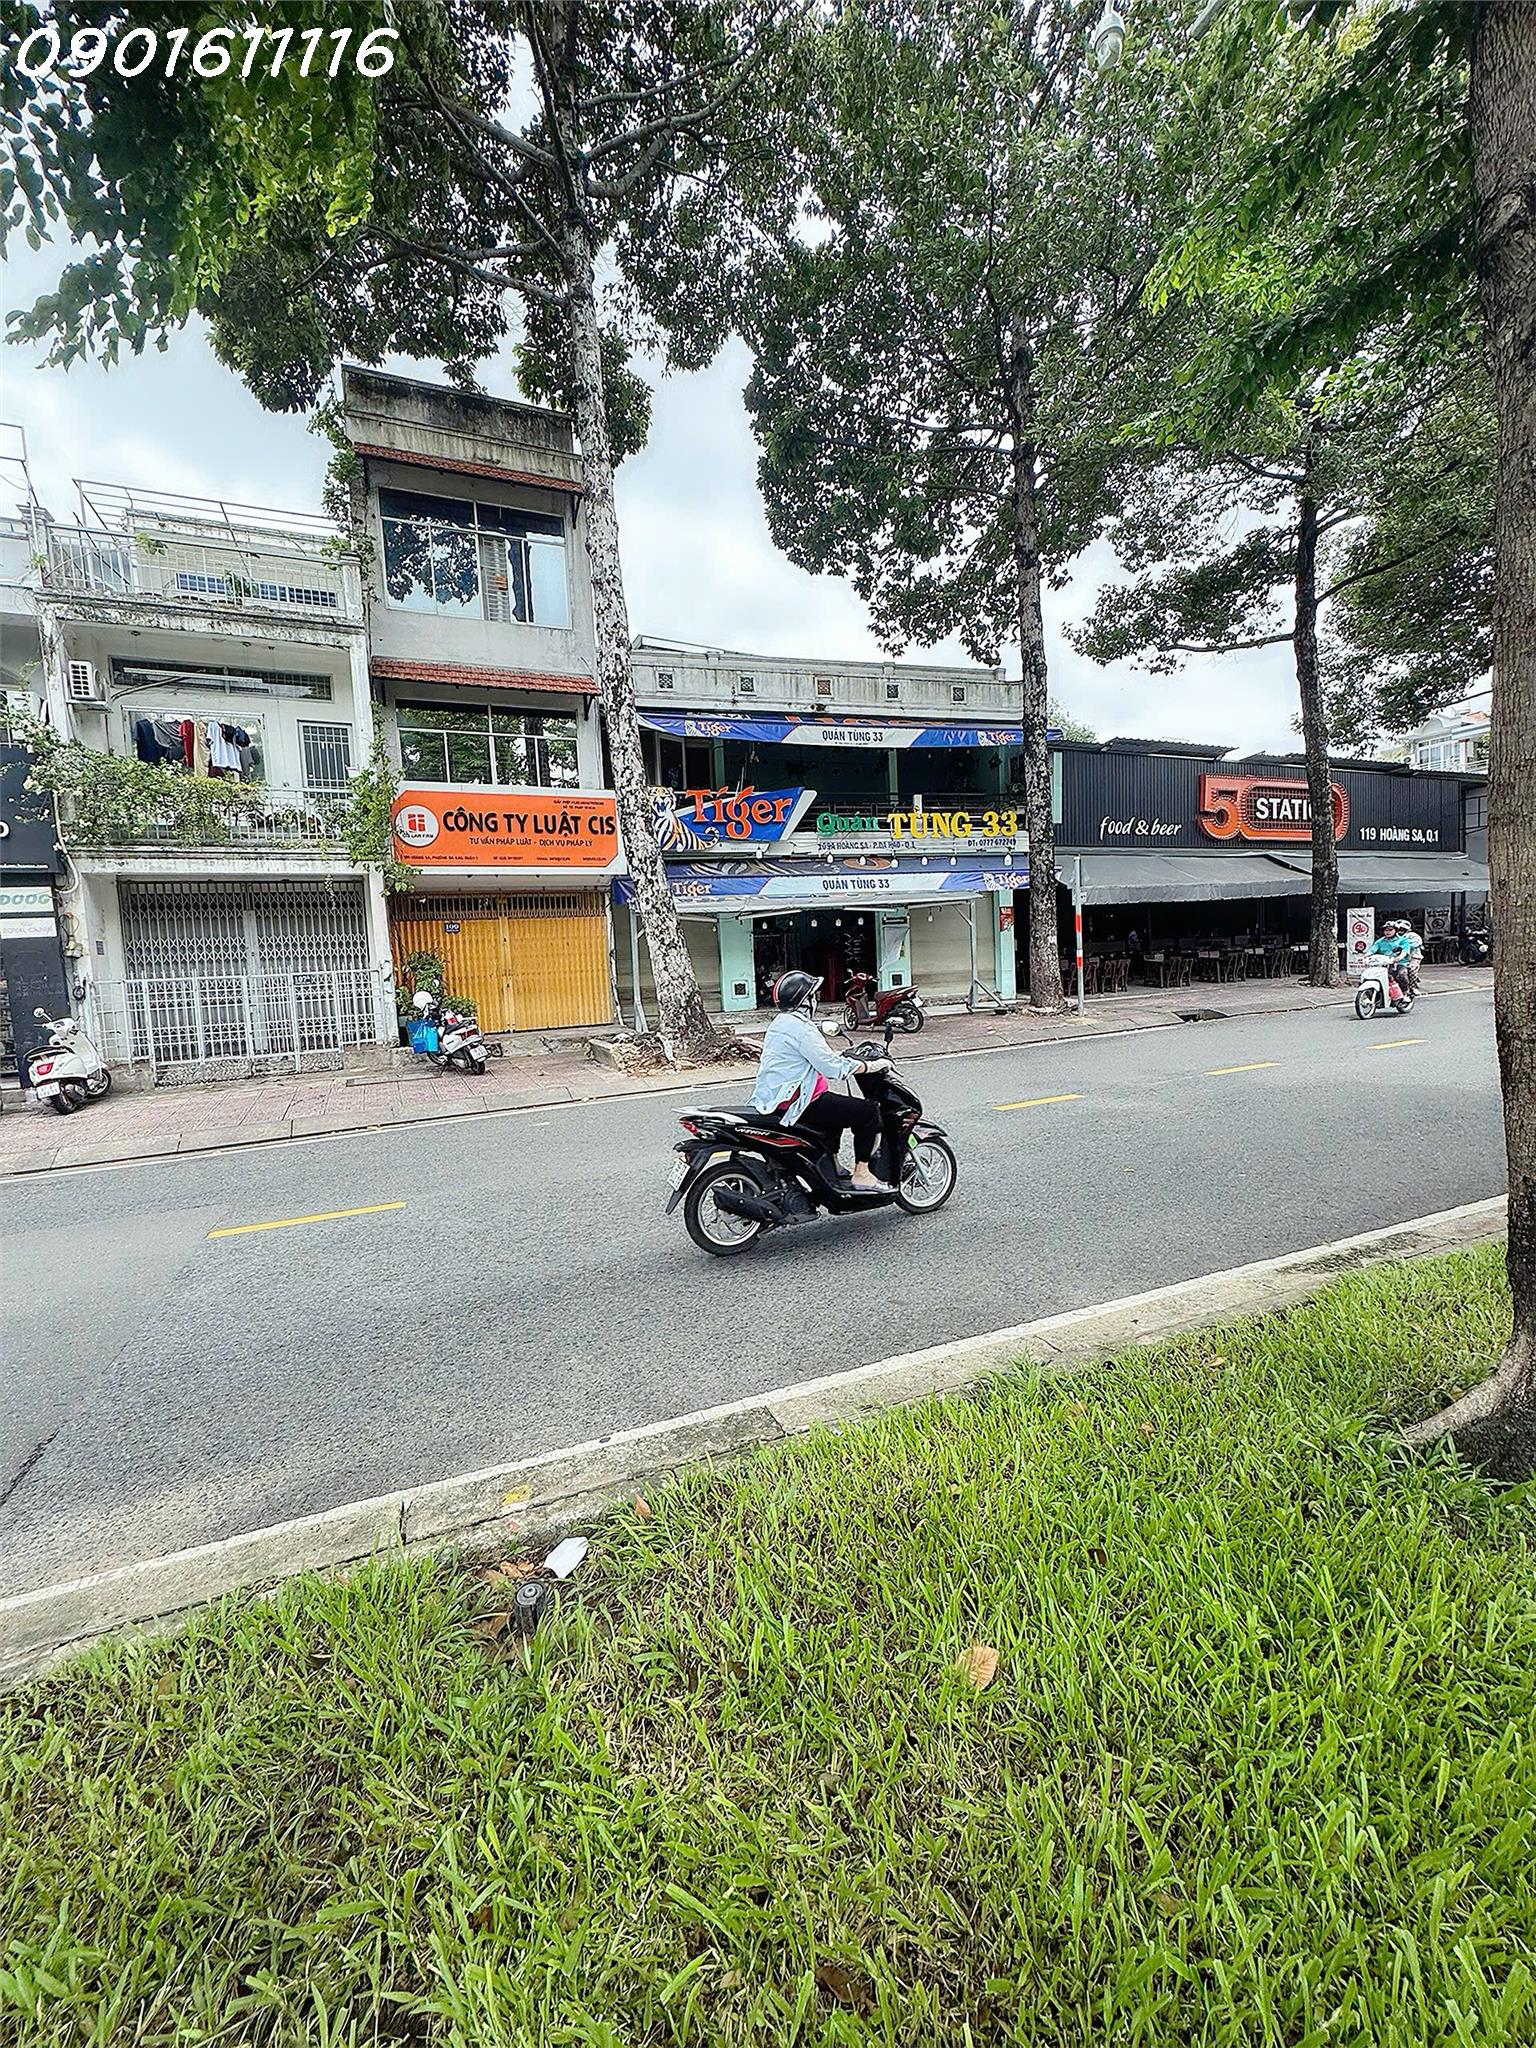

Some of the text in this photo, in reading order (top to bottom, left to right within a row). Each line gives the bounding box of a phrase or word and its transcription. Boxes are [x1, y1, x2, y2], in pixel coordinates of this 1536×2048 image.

[698, 720, 734, 737] Tiger
[822, 728, 884, 742] QUÁN TÙNG 33
[988, 731, 1016, 745] Tiger
[684, 785, 793, 839] Tiger
[443, 806, 616, 838] CÔNG TY LUẬT CIS
[816, 804, 1018, 839] Quán TÙNG 33
[1100, 816, 1182, 841] food & beer
[469, 837, 479, 845] TƯ
[496, 837, 515, 845] PHÁP
[516, 837, 532, 847] LUẬT
[566, 838, 584, 847] PHÁP
[1359, 825, 1439, 844] 119 HOÀNG SA, Q.1
[672, 879, 713, 896] Tiger
[822, 876, 890, 891] QUÁN TÙNG 33
[995, 872, 1030, 889] Tiger
